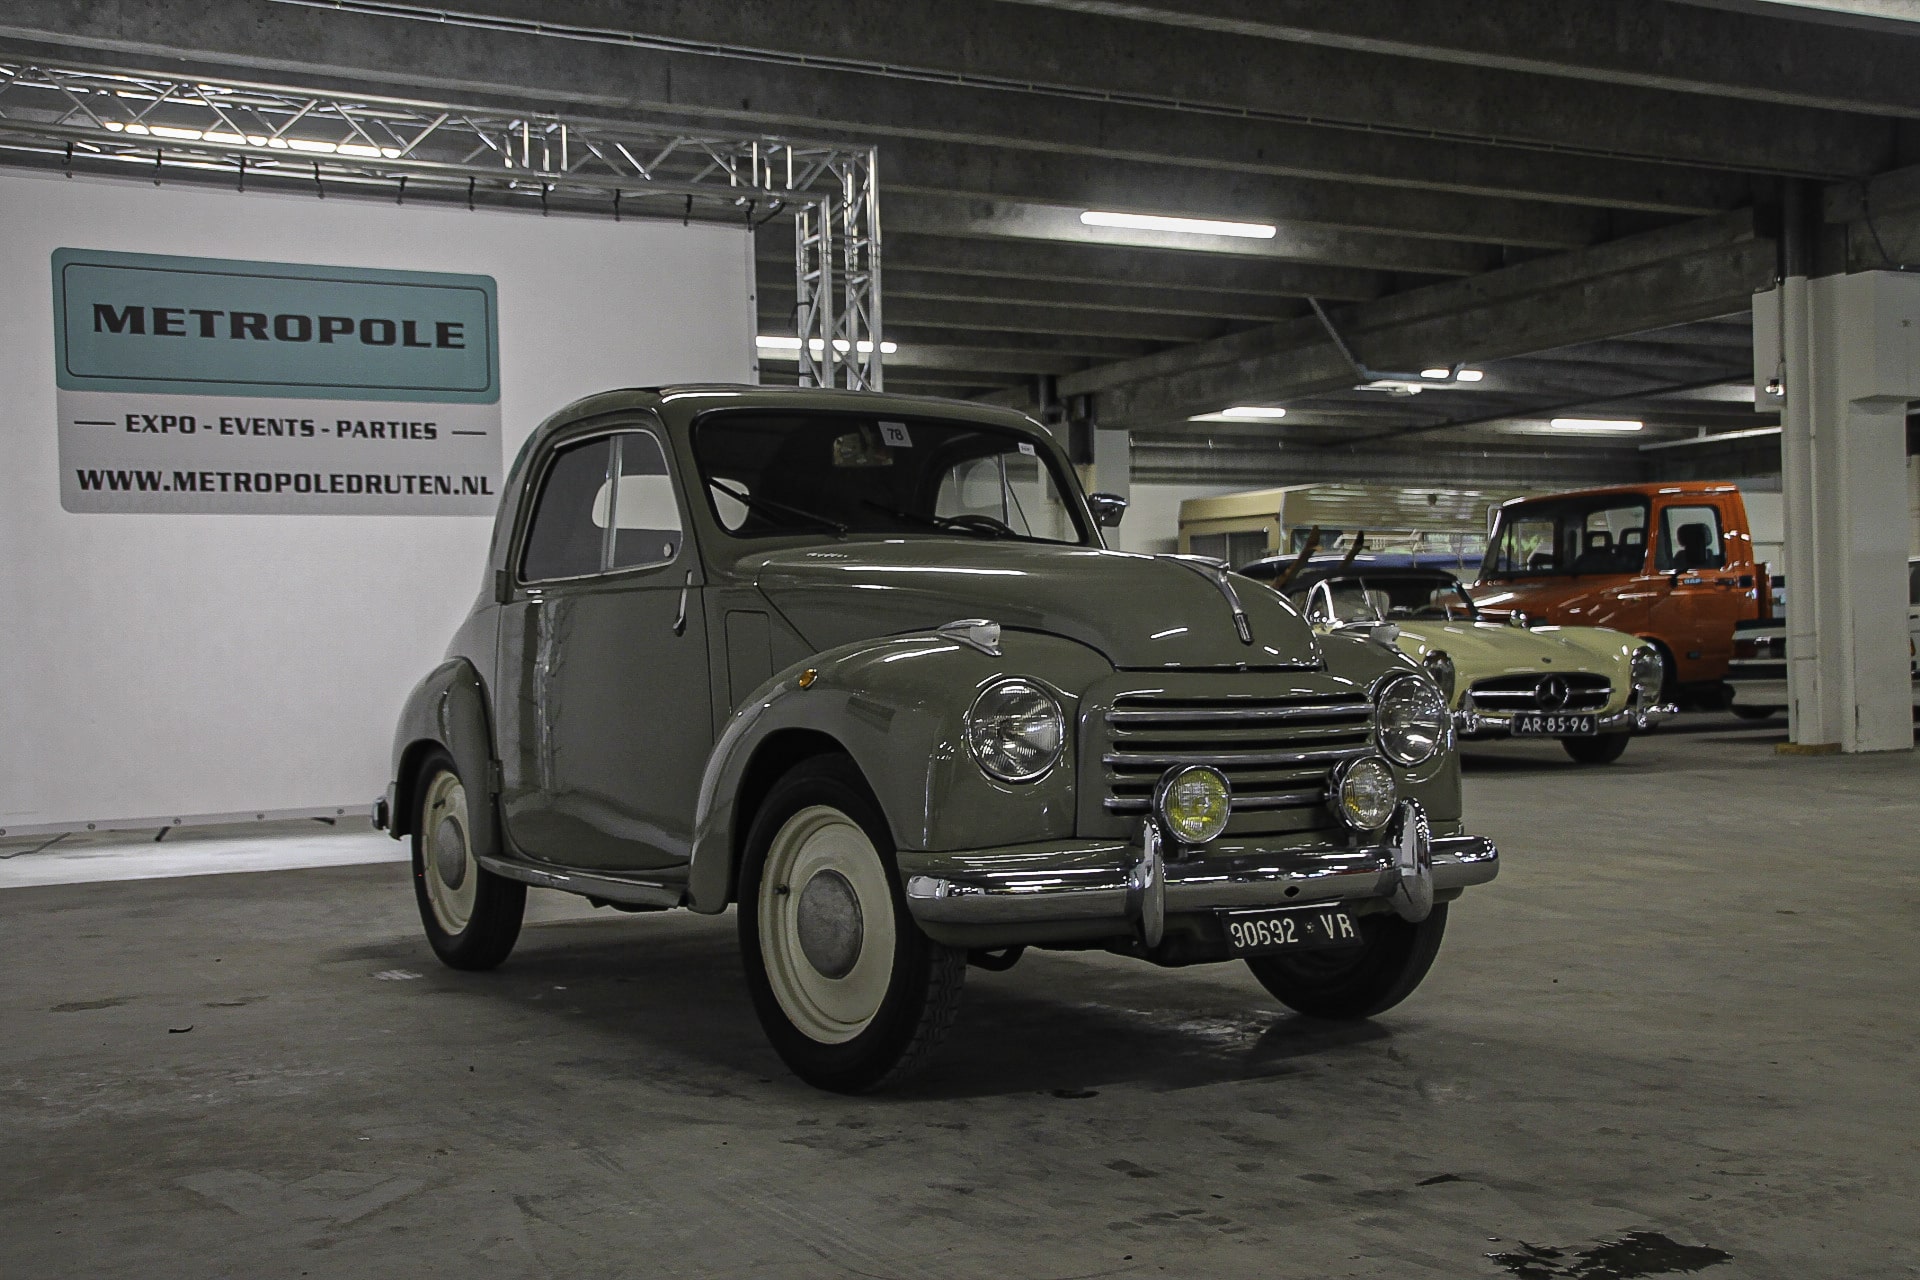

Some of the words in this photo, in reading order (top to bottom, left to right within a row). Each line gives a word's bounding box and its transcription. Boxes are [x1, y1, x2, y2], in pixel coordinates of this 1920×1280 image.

[93, 303, 466, 350] METROPOLE
[125, 413, 196, 435] EXPO
[219, 417, 315, 438] EVENTS
[336, 419, 438, 441] PARTIES
[887, 428, 904, 441] 78
[76, 468, 495, 497] WWW.METROPOLEDRUTEN.NL
[1230, 917, 1299, 948] 90692
[1319, 913, 1355, 939] VR
